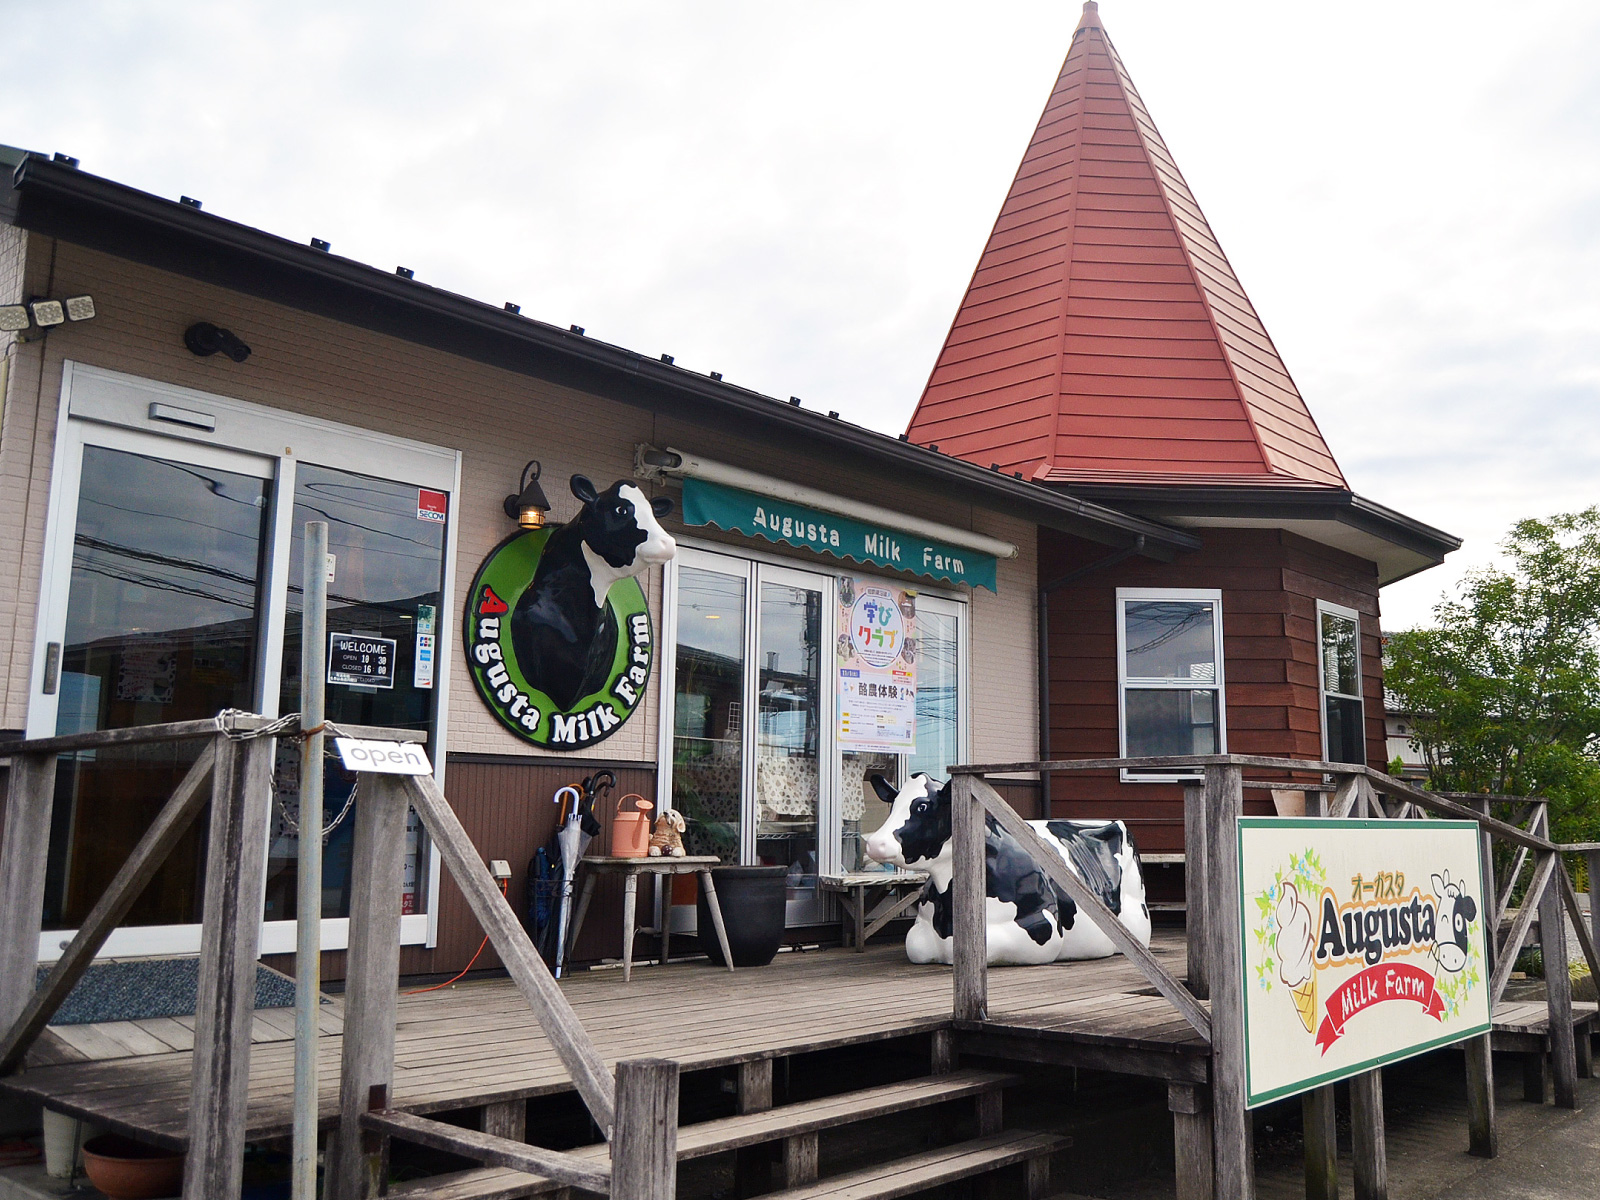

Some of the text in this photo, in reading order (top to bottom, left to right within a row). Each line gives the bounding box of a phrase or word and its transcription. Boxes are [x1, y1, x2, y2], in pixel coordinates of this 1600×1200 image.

[419, 510, 444, 520] SECOM
[753, 506, 965, 574] Augusta Milk Farm
[863, 601, 894, 627] 学び
[340, 640, 387, 655] WELCOME
[858, 625, 899, 649] クラブ
[475, 587, 650, 744] Augusta Milk Farm
[858, 682, 898, 699] 酪農体験
[350, 747, 421, 767] open
[1352, 870, 1405, 901] オーガスタ
[1316, 895, 1436, 966] Augusta
[1341, 969, 1425, 1021] Milk Farm
